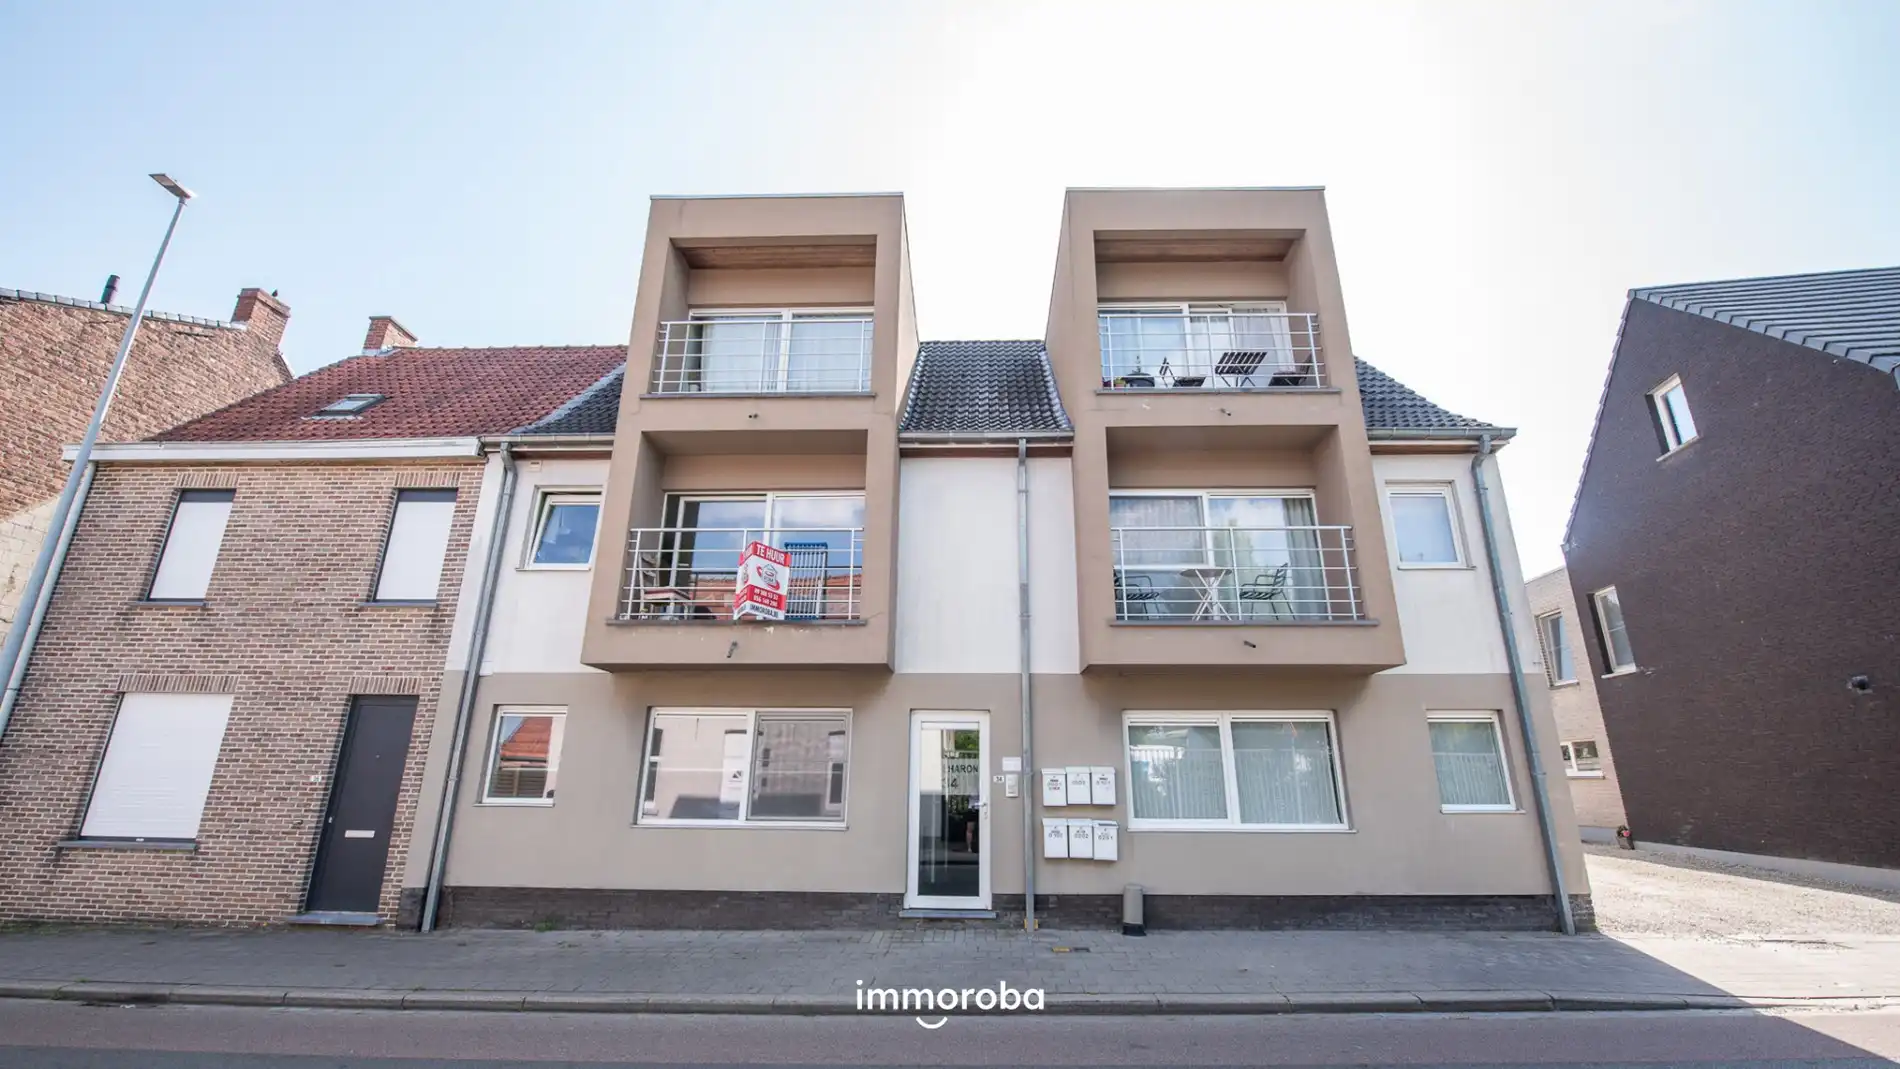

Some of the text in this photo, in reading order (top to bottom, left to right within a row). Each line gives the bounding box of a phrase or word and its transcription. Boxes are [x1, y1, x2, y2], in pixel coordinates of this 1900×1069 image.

[756, 544, 765, 557] TE
[766, 549, 785, 565] HUUR
[941, 764, 979, 774] HARON
